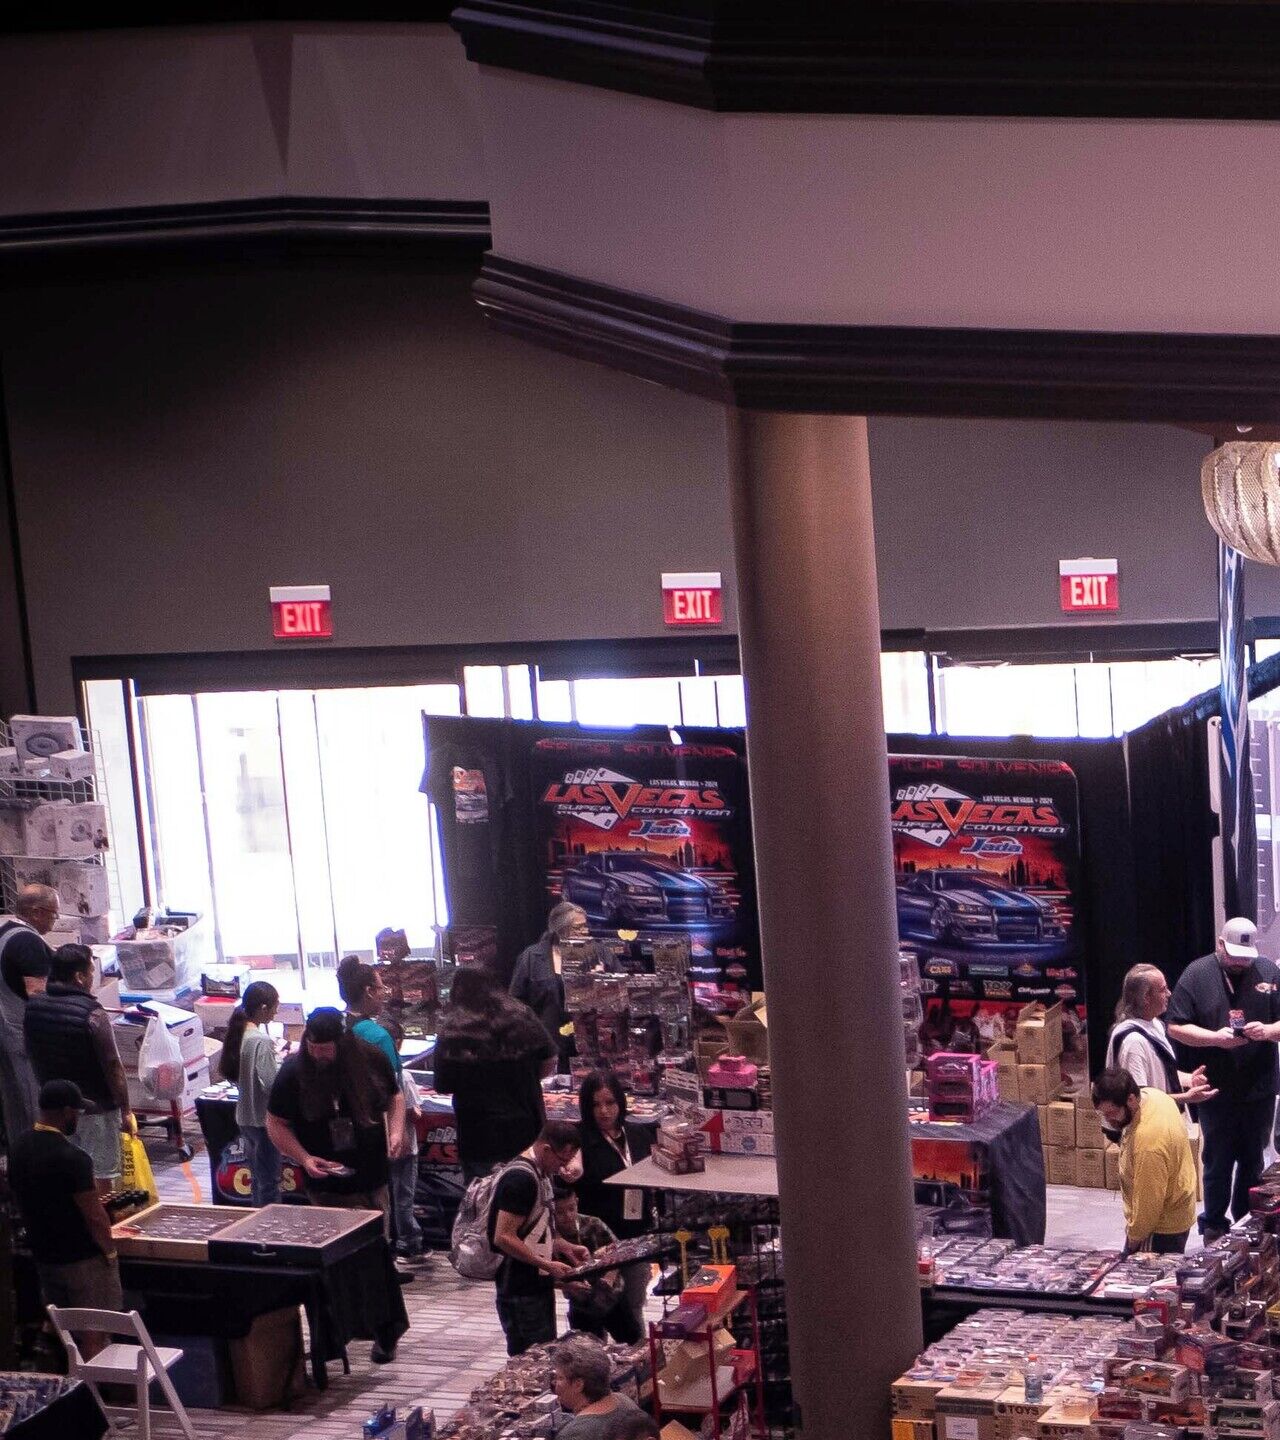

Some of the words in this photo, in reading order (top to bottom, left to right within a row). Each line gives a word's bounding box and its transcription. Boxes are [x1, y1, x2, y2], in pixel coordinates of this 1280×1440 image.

[1070, 576, 1108, 606] EXIT
[673, 590, 712, 619] EXIT
[281, 603, 322, 633] EXIT
[544, 783, 606, 803] LAS
[600, 782, 725, 819] VEGAS
[557, 804, 613, 812] SUPER
[630, 807, 732, 817] CONVENTION
[629, 820, 691, 838] Jada
[891, 801, 938, 821] AS
[930, 799, 1060, 836] VEGAS
[963, 824, 1065, 834] CONVENTION
[961, 837, 1023, 854] Jada
[1008, 1405, 1039, 1415] TOYS
